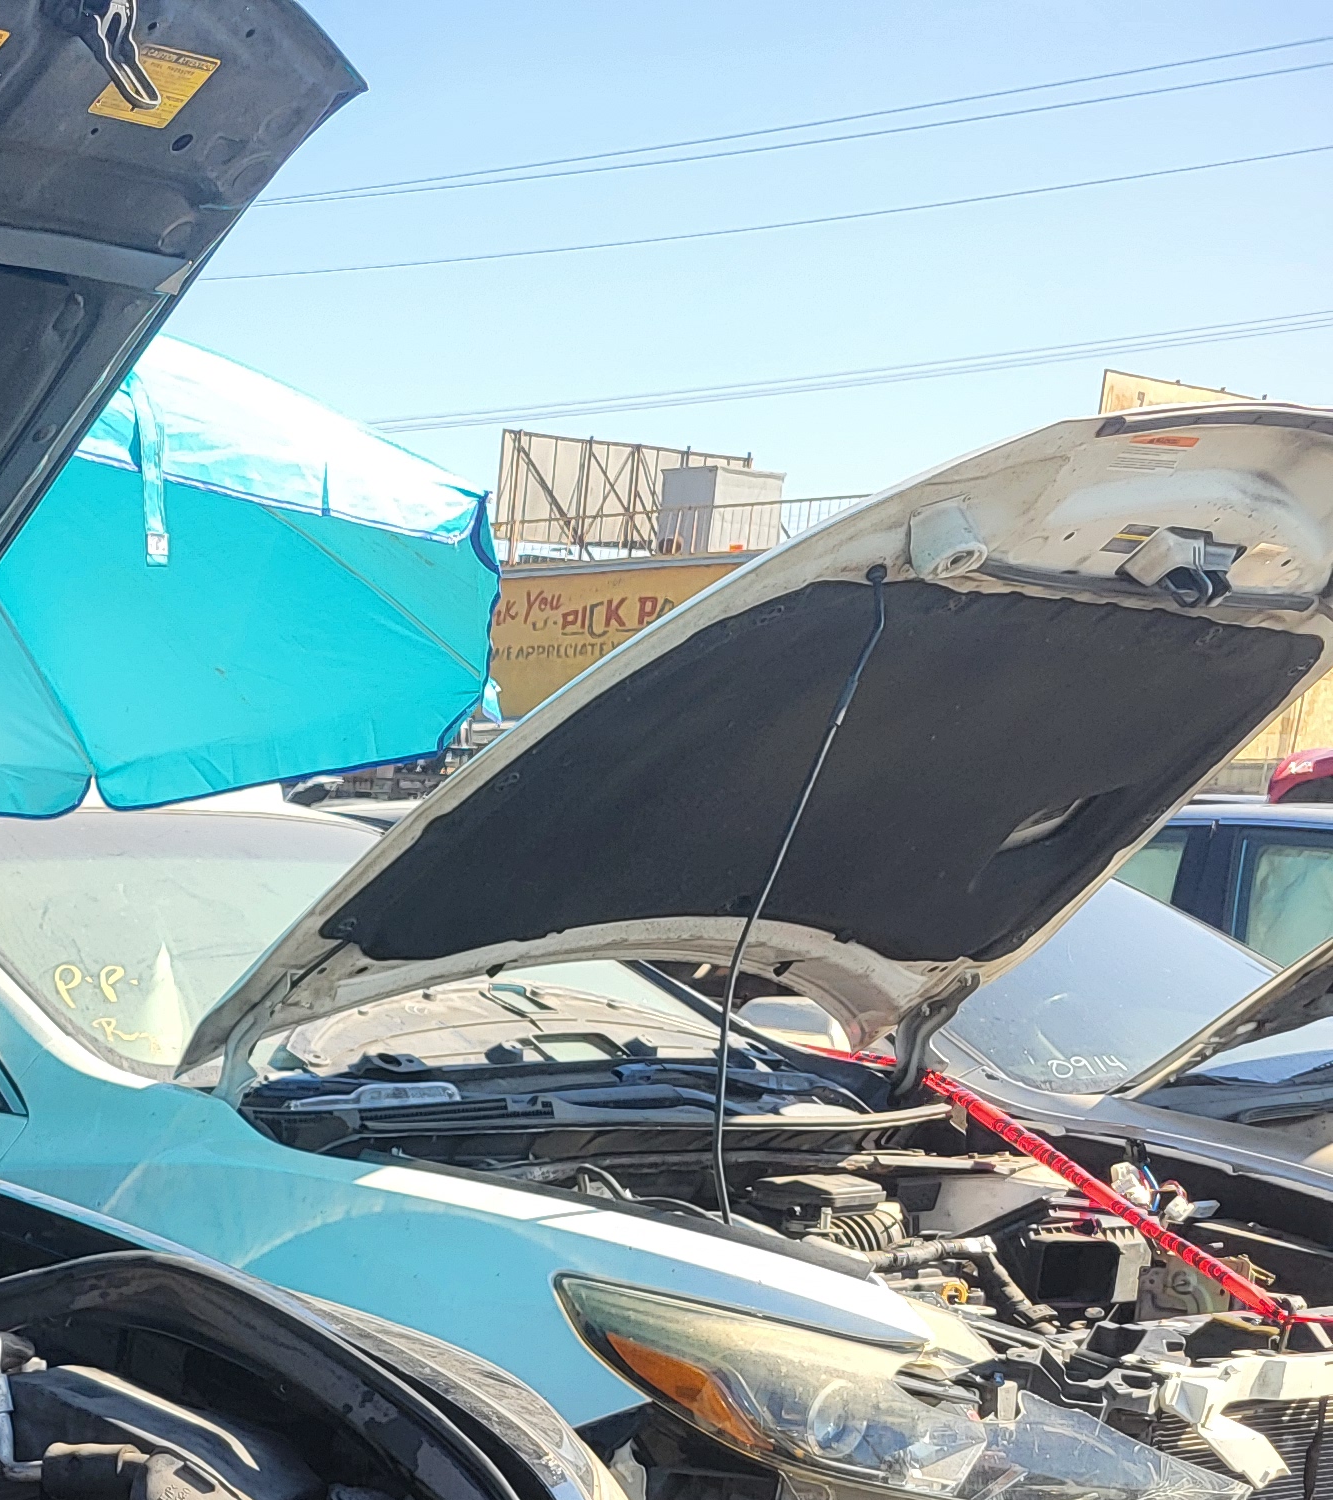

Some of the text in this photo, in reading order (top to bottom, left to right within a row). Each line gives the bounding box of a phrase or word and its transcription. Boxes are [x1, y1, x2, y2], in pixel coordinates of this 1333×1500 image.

[523, 589, 562, 625] You
[561, 596, 628, 639] PICK
[515, 642, 607, 660] APPRECIATE
[1047, 1054, 1128, 1079] 0914
